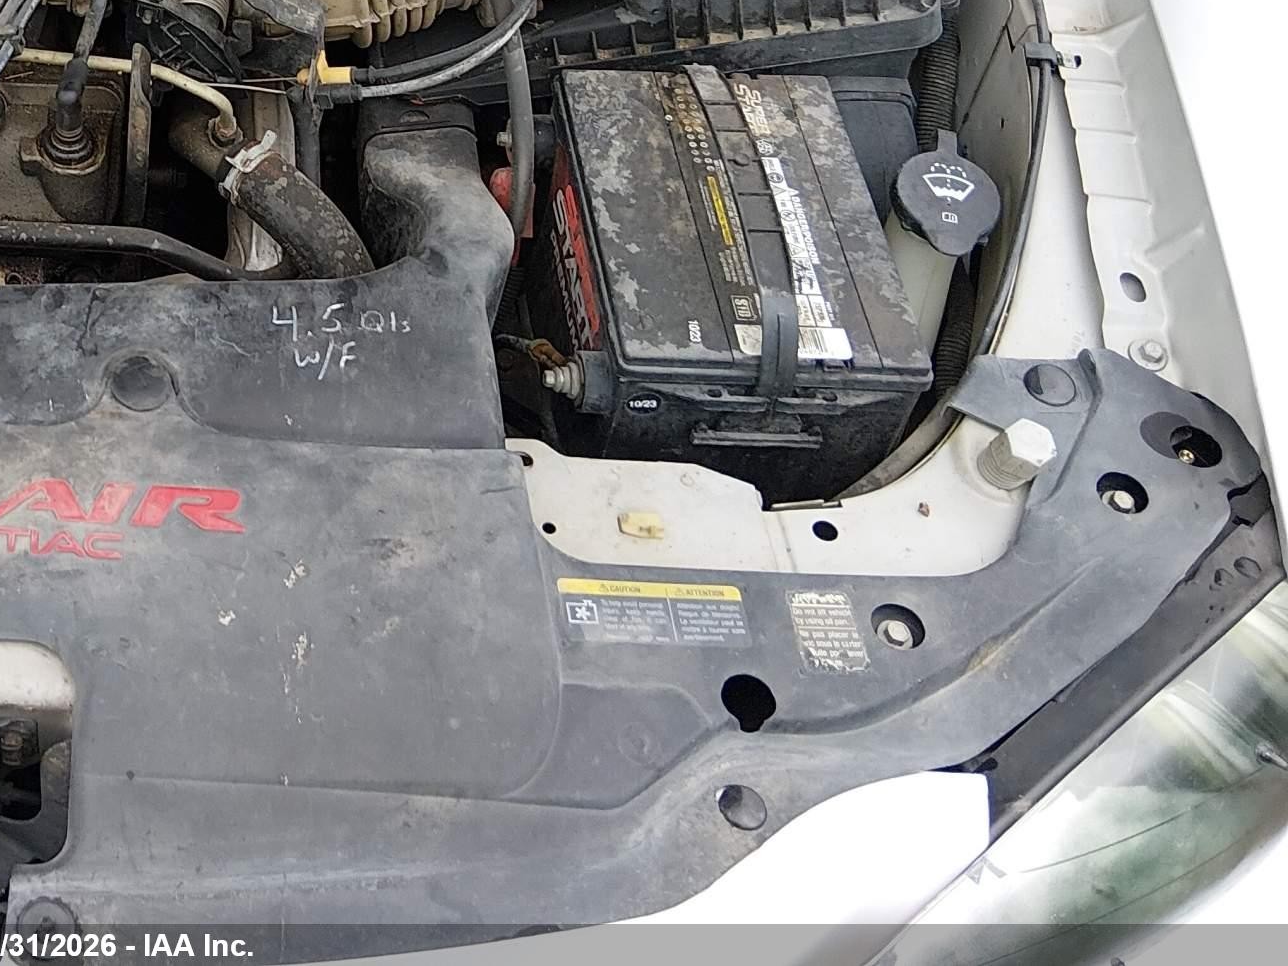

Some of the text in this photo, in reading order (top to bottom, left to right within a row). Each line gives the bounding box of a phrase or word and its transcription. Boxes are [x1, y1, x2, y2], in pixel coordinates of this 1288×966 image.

[750, 89, 771, 135] SUPER
[552, 189, 593, 352] START
[628, 398, 657, 409] 10/23
